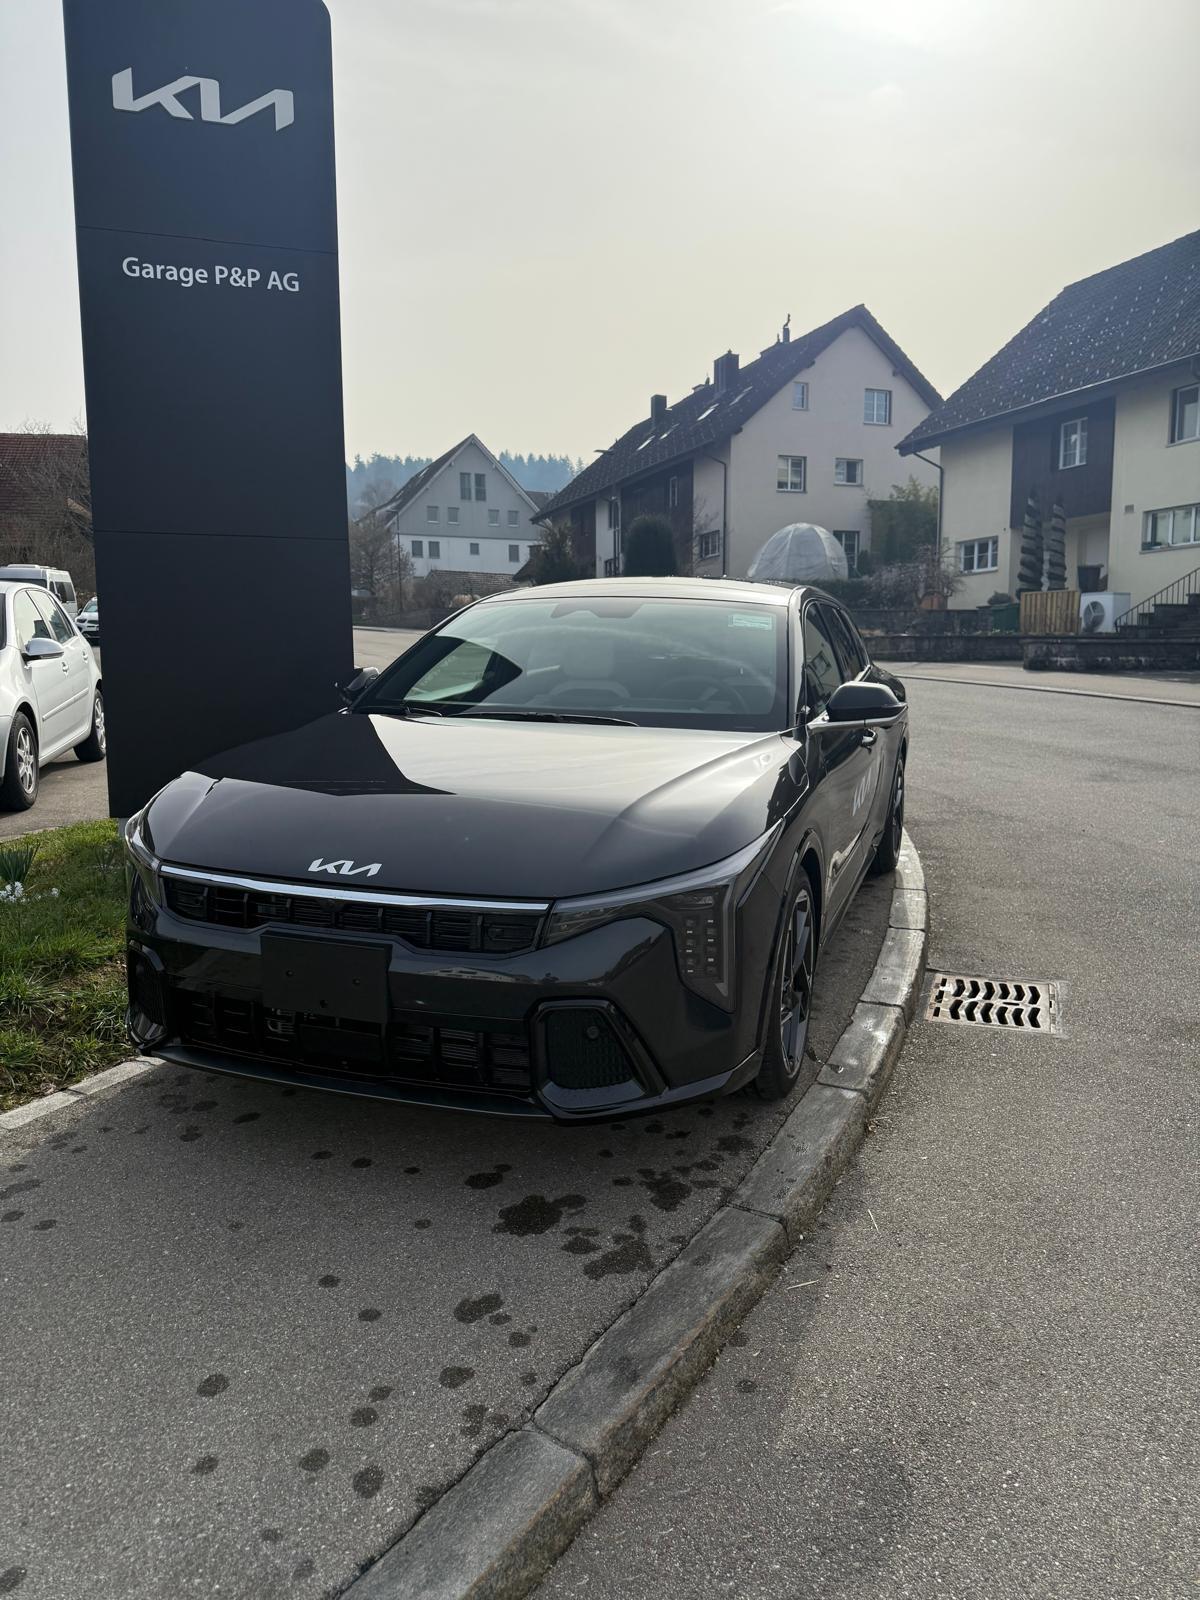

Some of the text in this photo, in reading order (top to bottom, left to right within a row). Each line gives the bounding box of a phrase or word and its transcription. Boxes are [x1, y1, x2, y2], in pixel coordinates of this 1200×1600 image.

[111, 67, 295, 132] KIA
[122, 256, 300, 292] Garage P&P AG
[307, 857, 383, 877] KIA
